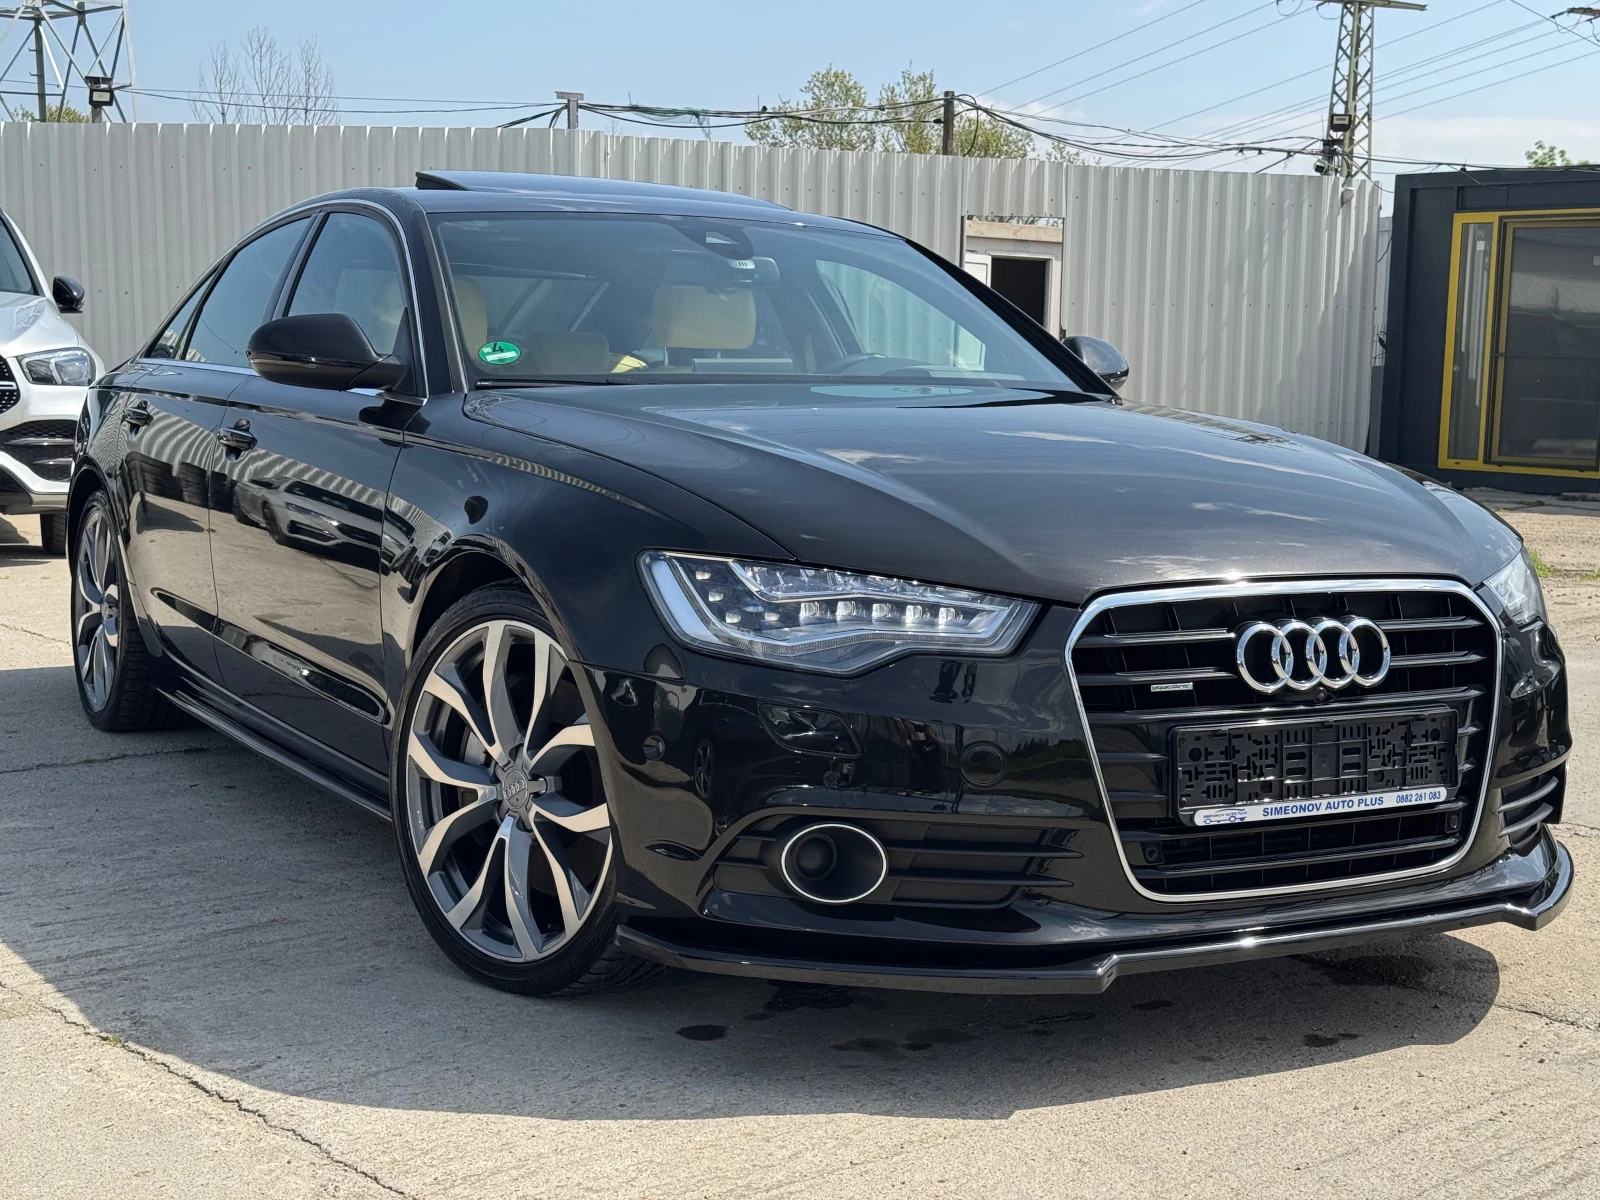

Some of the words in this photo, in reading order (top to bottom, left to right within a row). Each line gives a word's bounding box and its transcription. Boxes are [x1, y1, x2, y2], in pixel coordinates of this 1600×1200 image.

[492, 342, 505, 353] 4
[1396, 793, 1413, 804] 0882
[1414, 792, 1427, 802] 261
[1428, 790, 1441, 801] 083
[1262, 802, 1322, 816] SIMEONOV
[1325, 800, 1354, 810] AUTO
[1358, 796, 1384, 808] PLUS
